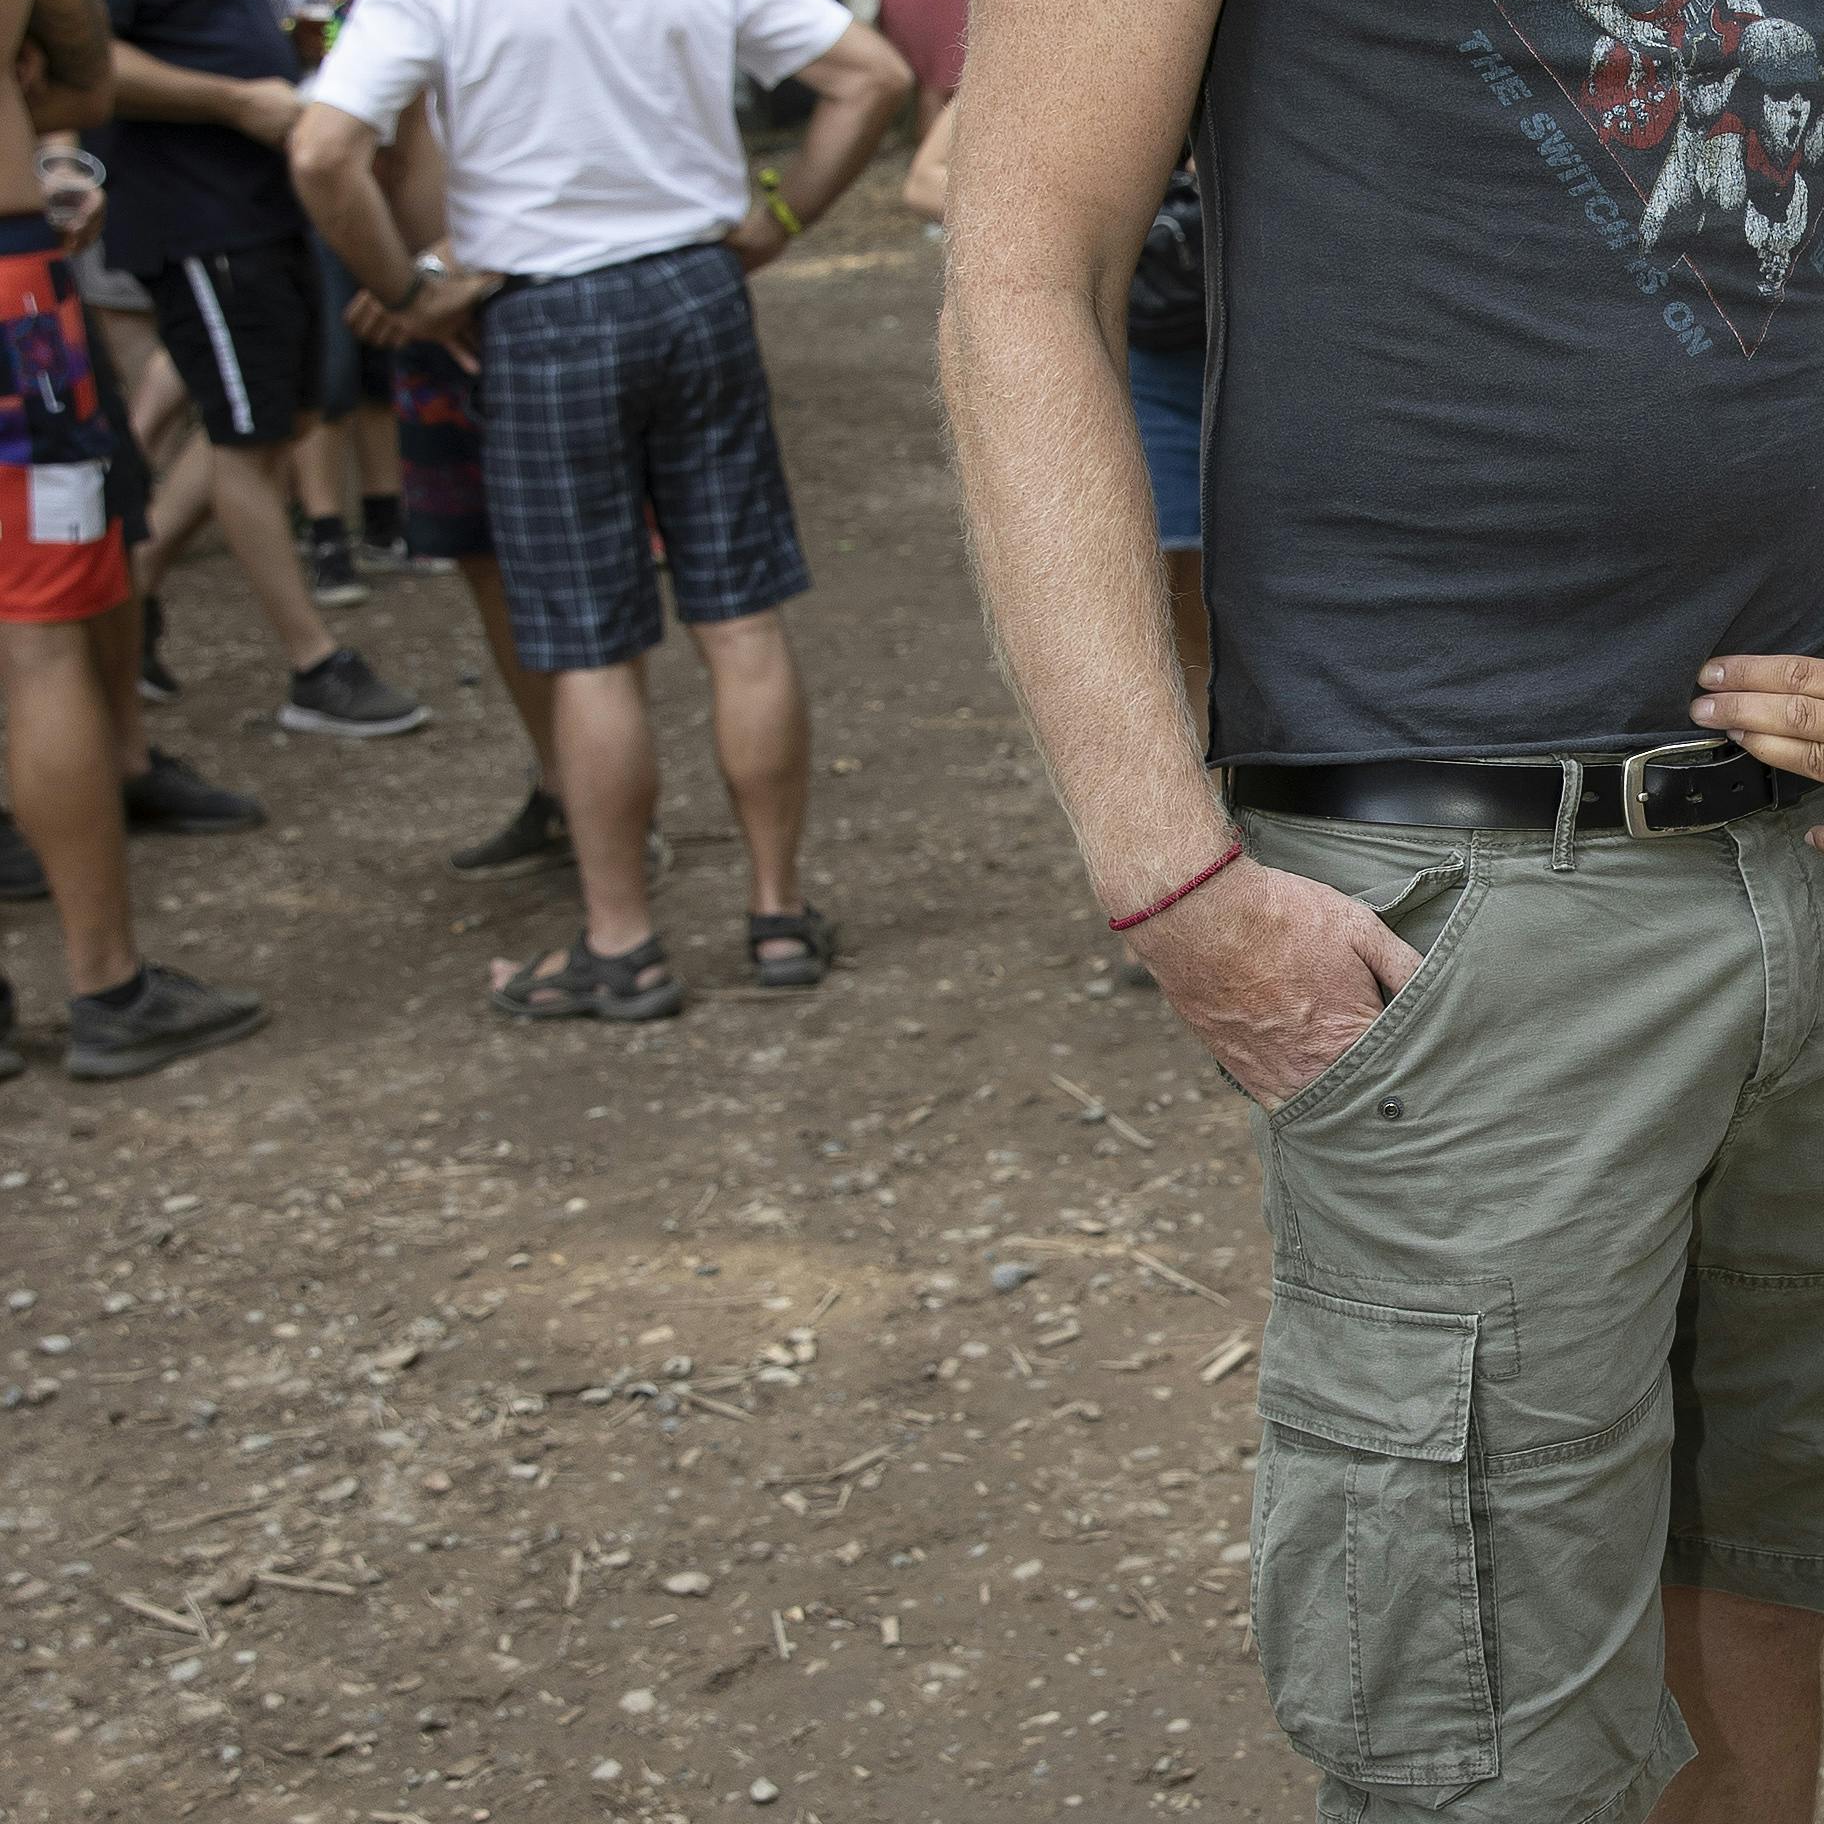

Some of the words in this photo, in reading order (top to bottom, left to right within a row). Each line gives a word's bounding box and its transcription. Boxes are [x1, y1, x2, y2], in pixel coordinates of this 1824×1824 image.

[1457, 28, 1533, 107] THE
[1519, 112, 1639, 251] SWITCH
[1662, 300, 1713, 357] ON
